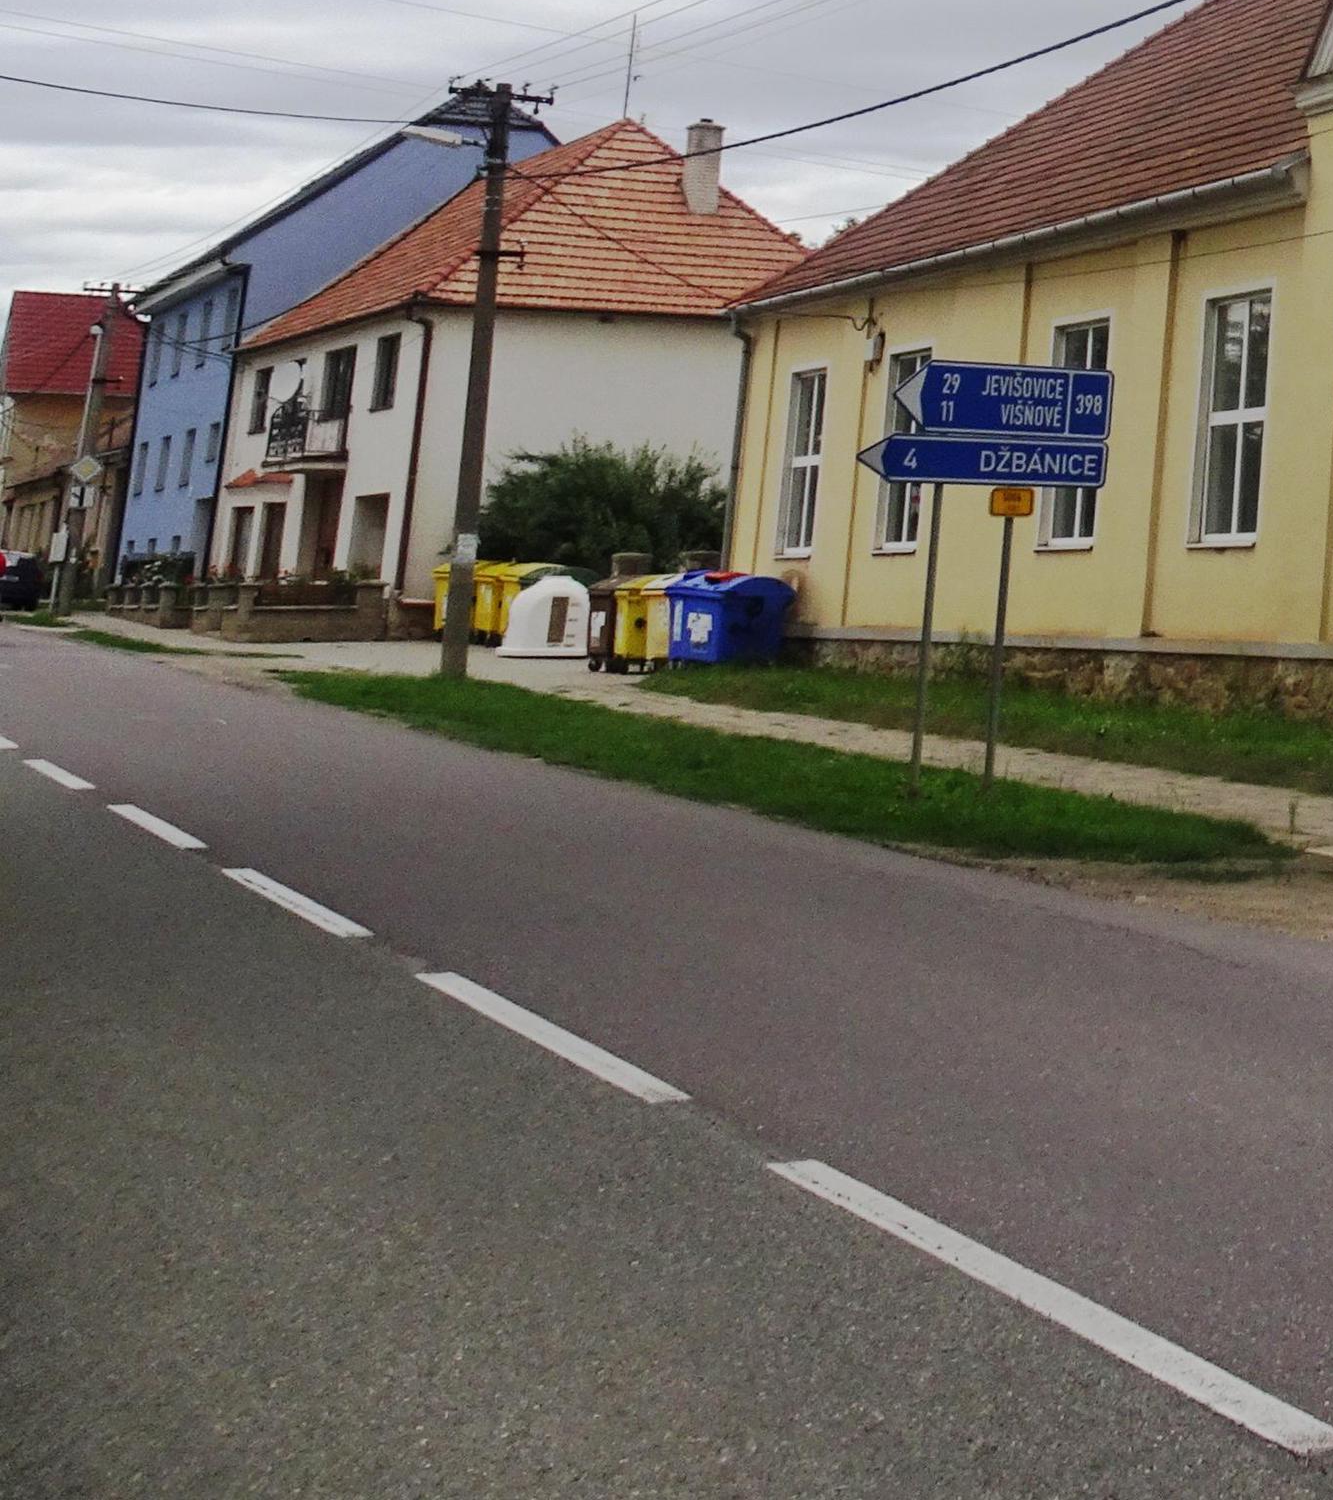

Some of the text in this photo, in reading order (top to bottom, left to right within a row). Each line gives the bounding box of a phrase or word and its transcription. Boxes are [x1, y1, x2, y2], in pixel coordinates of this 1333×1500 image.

[942, 372, 1064, 399] 29 JEVIŠOVICE
[940, 400, 1063, 428] 11 VIŠŇOVÉ
[1075, 394, 1102, 416] 398
[903, 446, 1098, 476] 4 DŽBÁNICE
